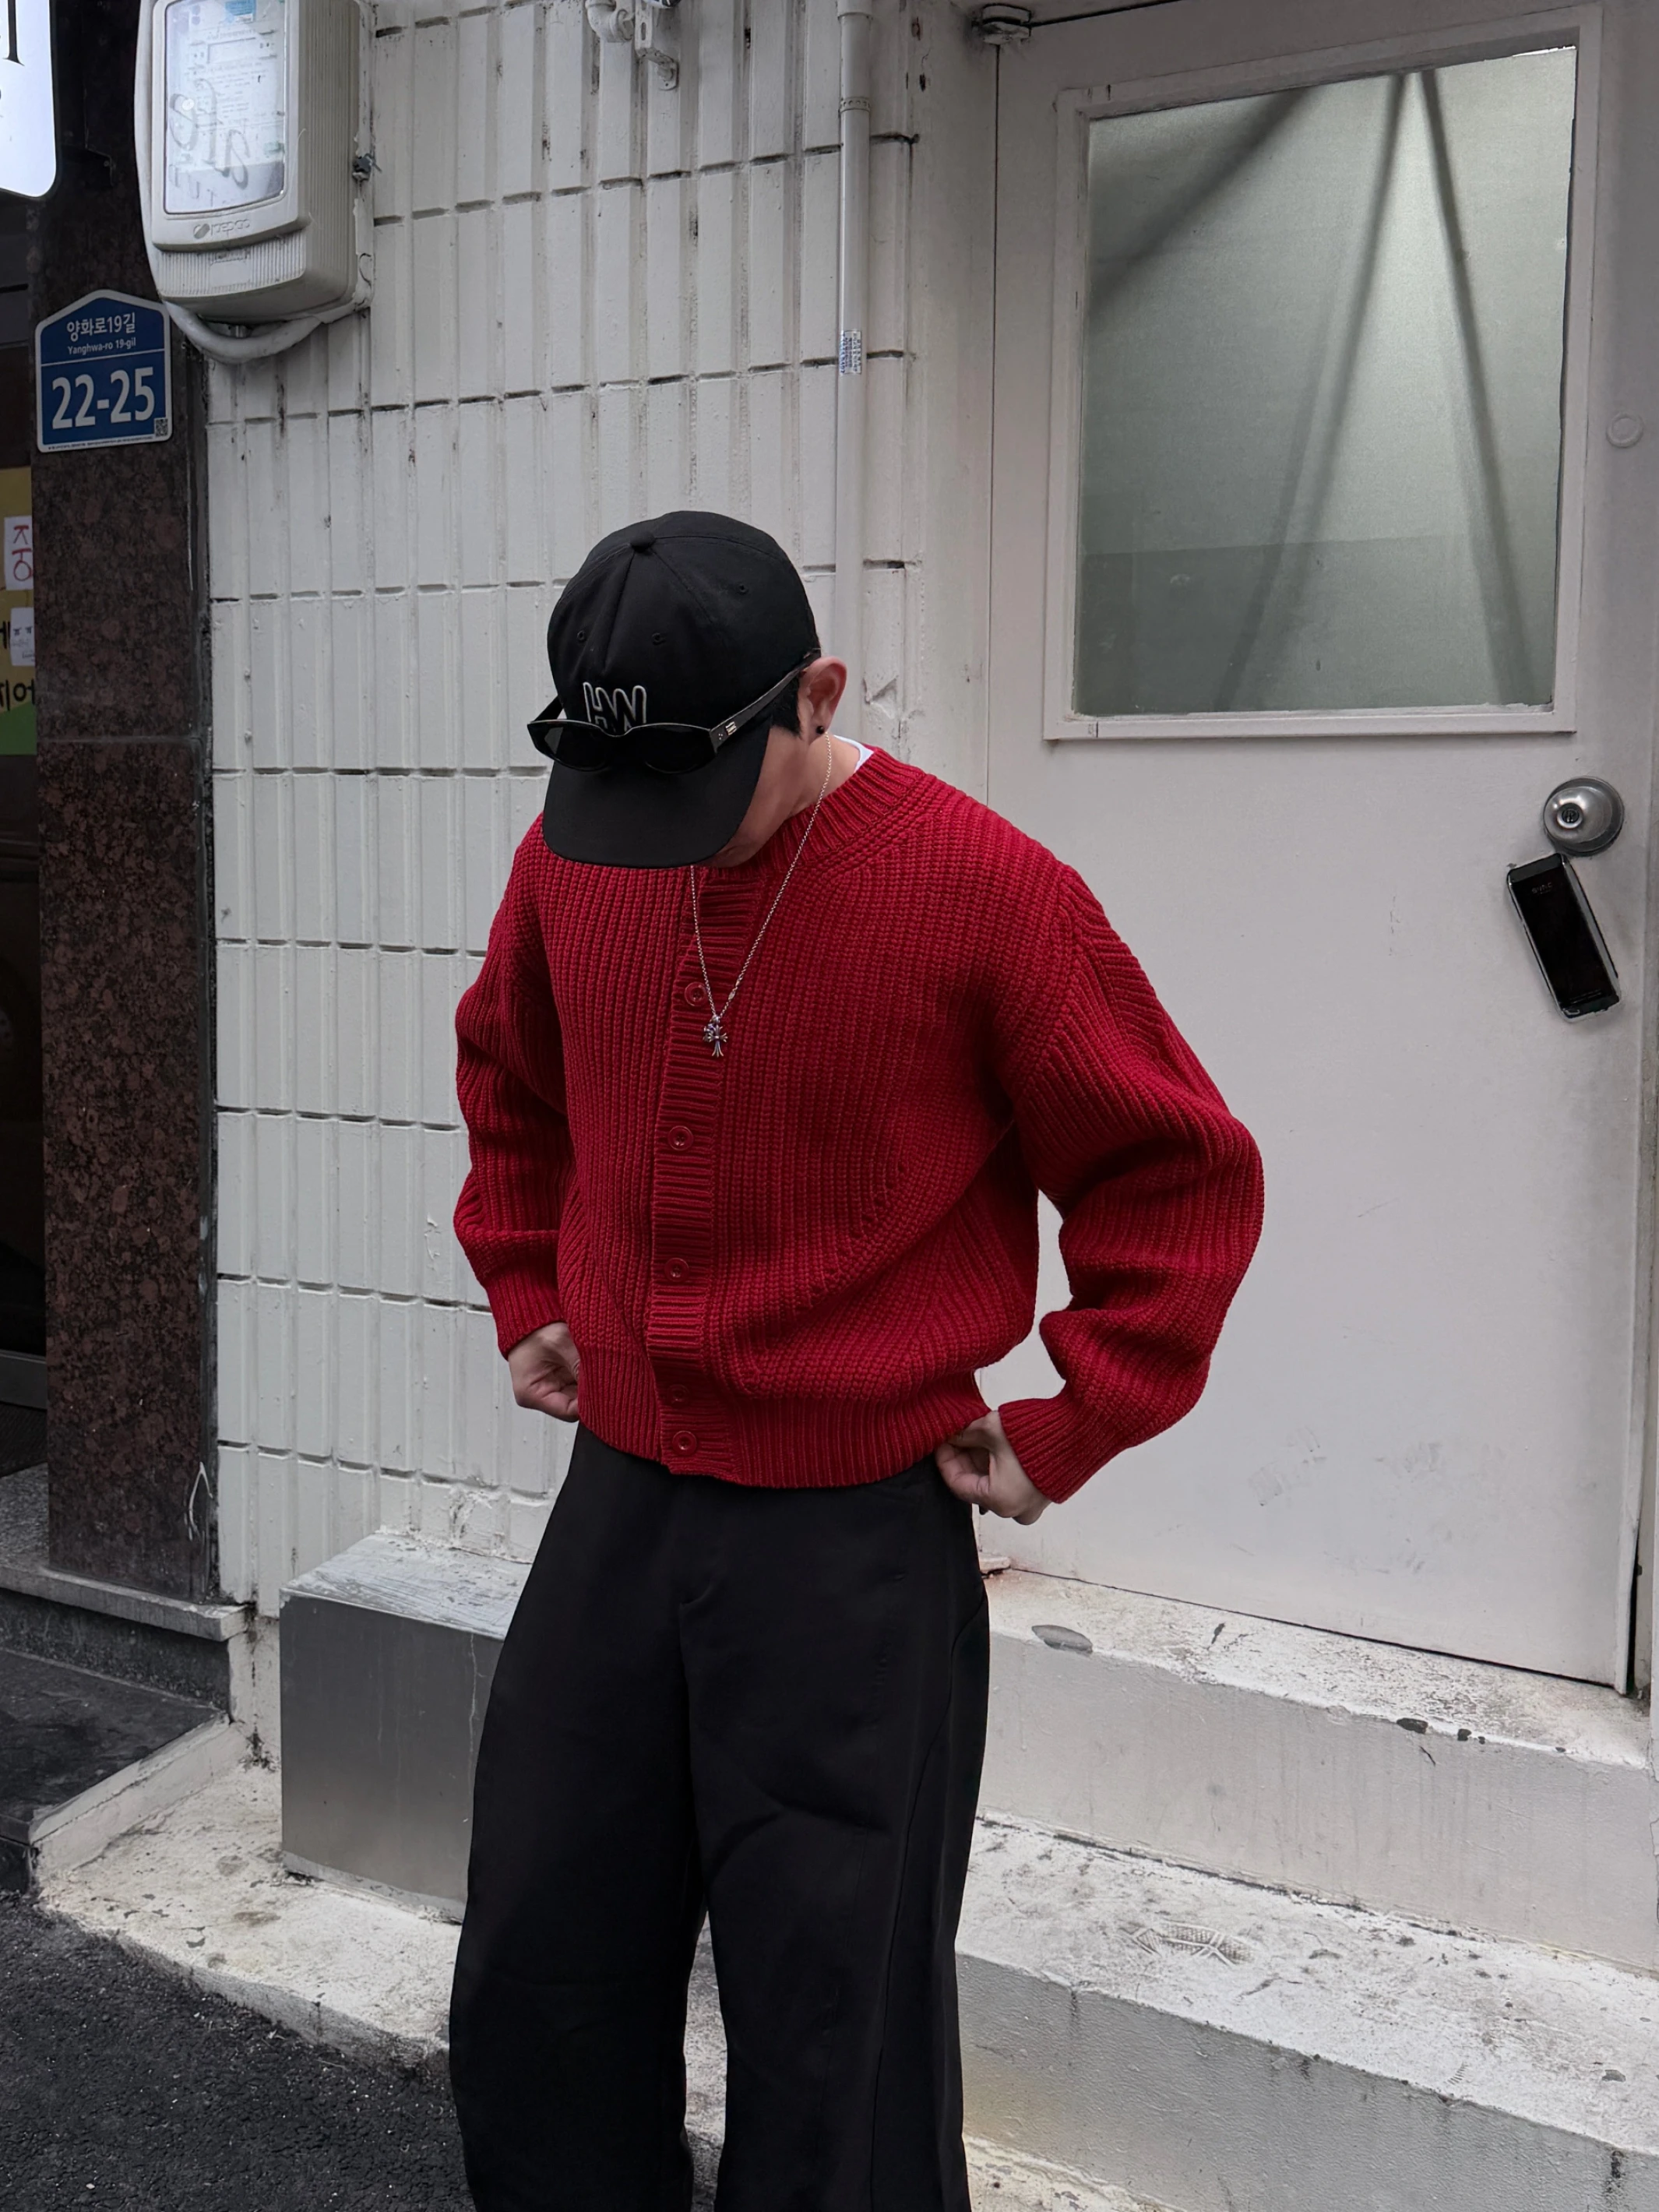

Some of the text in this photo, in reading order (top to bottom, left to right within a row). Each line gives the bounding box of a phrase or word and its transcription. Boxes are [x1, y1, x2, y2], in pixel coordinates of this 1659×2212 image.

[67, 312, 136, 342] 양화로19길
[68, 337, 136, 355] Yanghwa-ro 19-gil
[52, 367, 155, 429] 22-25
